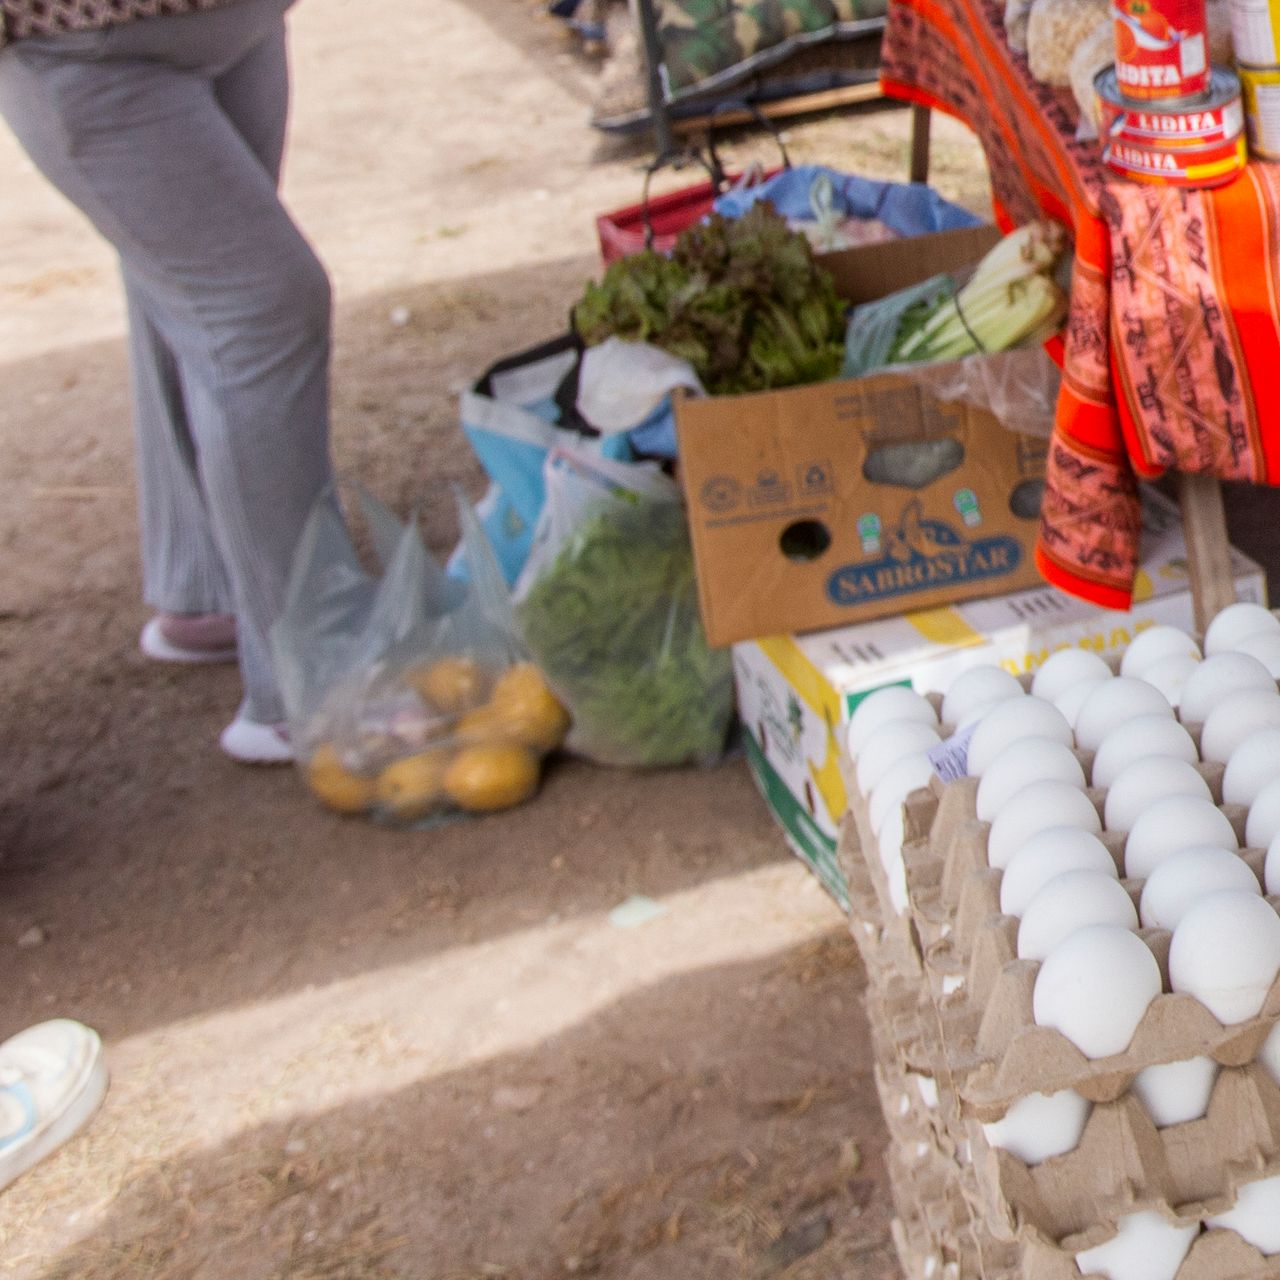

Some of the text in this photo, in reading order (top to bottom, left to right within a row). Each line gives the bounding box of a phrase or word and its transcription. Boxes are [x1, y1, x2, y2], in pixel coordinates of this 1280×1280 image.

[1138, 112, 1218, 132] LIDITA
[1115, 145, 1178, 170] LIDITA
[838, 545, 1011, 600] SABROSTAR
